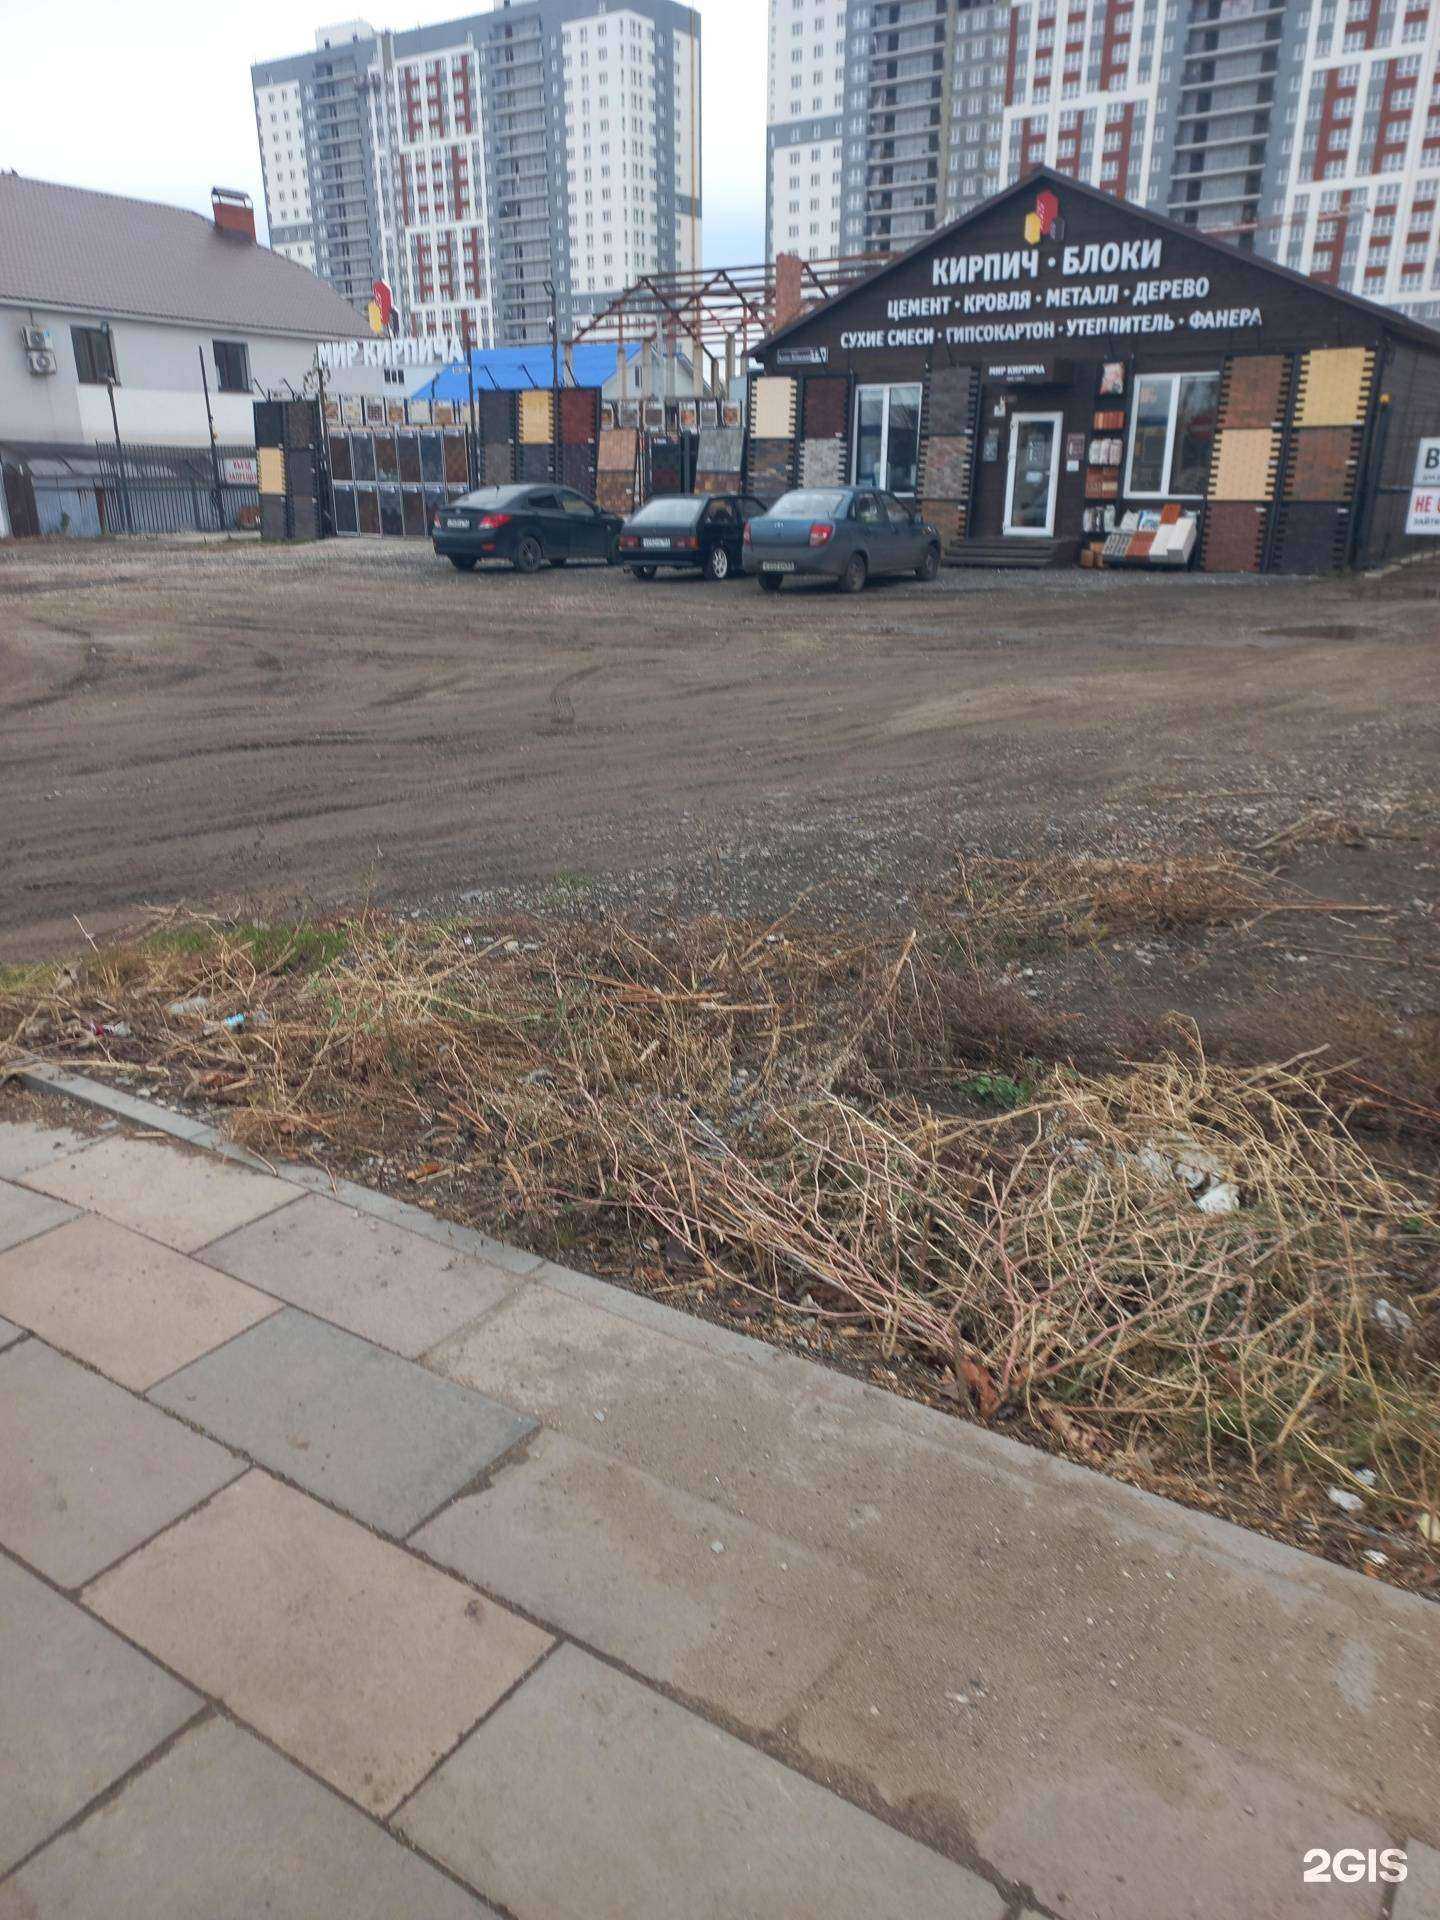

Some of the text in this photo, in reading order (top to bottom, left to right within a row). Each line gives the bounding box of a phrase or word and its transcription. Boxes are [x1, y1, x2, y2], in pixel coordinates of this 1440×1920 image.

[932, 239, 1162, 286] КИРПИЧ БЛОКИ
[887, 276, 1210, 321] ЦЕМЕНТ КРОВЛЯ МЕТАЛЛ ДЕРЕВО
[840, 307, 1263, 349] СУХИЕ СМЕСИ ГИПСОКАРТОН УТЕПЛИТЕЛЬ ФАНЕРА
[317, 336, 465, 369] МИР КИРПИЧА
[1414, 495, 1432, 513] НЕ
